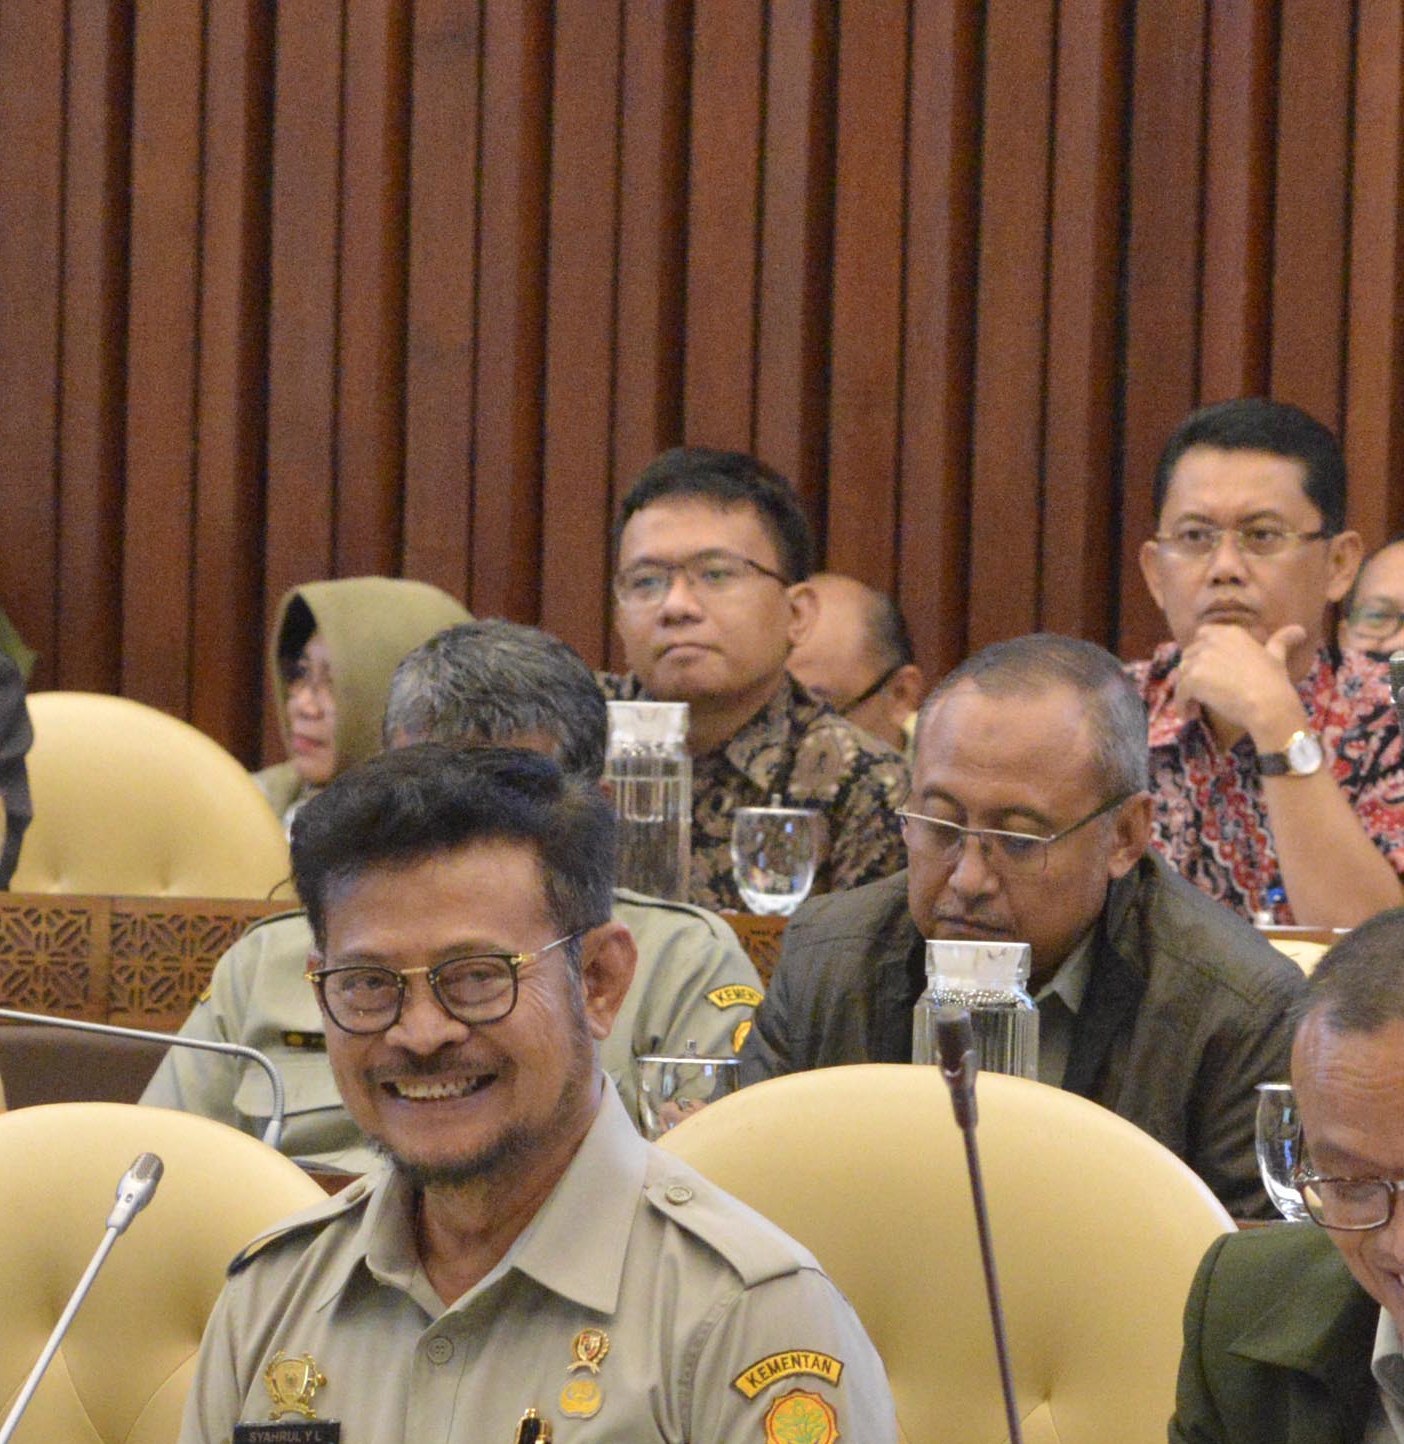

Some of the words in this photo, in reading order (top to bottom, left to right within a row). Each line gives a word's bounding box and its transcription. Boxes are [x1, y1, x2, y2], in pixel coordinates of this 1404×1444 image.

[744, 1353, 833, 1389] KEMENTAN
[249, 1430, 302, 1443] SYAHRUL
[305, 1430, 314, 1442] Y
[314, 1430, 322, 1441] L
